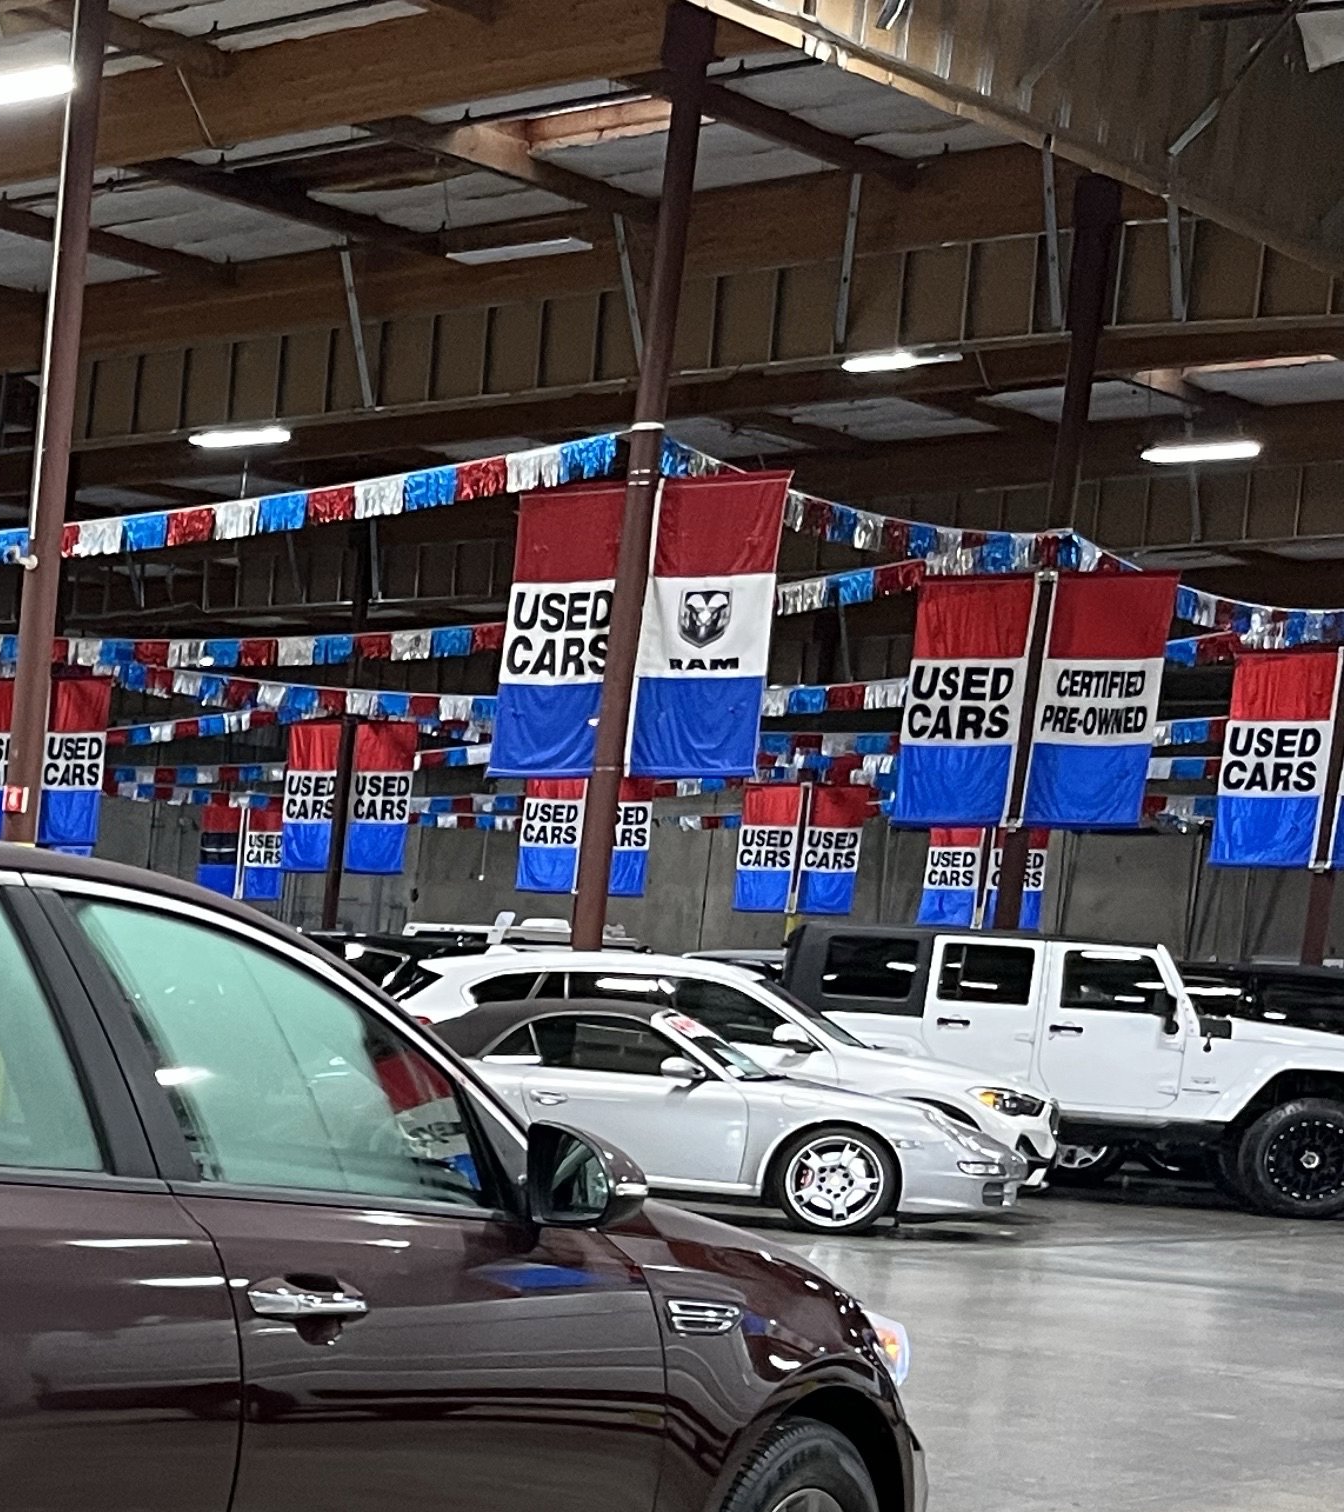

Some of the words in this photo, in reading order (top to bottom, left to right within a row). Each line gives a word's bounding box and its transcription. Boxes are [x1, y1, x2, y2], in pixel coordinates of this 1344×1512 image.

[513, 590, 615, 632] USED
[506, 634, 610, 677] CARS
[668, 657, 739, 670] RAM
[912, 665, 1014, 701] USED
[1056, 668, 1147, 698] CERTIFIED
[908, 703, 1010, 740] CARS
[1040, 704, 1148, 736] PRE-OWNED
[47, 737, 103, 761] USED
[1229, 726, 1321, 758] USED
[44, 763, 100, 786] CARS
[1223, 760, 1317, 792] CARS
[288, 775, 336, 797] USED
[355, 775, 410, 798] USED
[285, 798, 334, 820] CARS
[353, 798, 408, 821] CARS
[525, 803, 579, 823] USED
[616, 805, 649, 825] ED
[248, 834, 283, 850] USED
[522, 824, 577, 844] CARS
[619, 828, 648, 847] RS
[742, 829, 794, 848] USED
[807, 830, 859, 850] USED
[246, 850, 282, 865] CARS
[739, 849, 791, 868] CARS
[804, 850, 857, 870] CARS
[930, 851, 977, 868] USED
[927, 870, 975, 887] CARS
